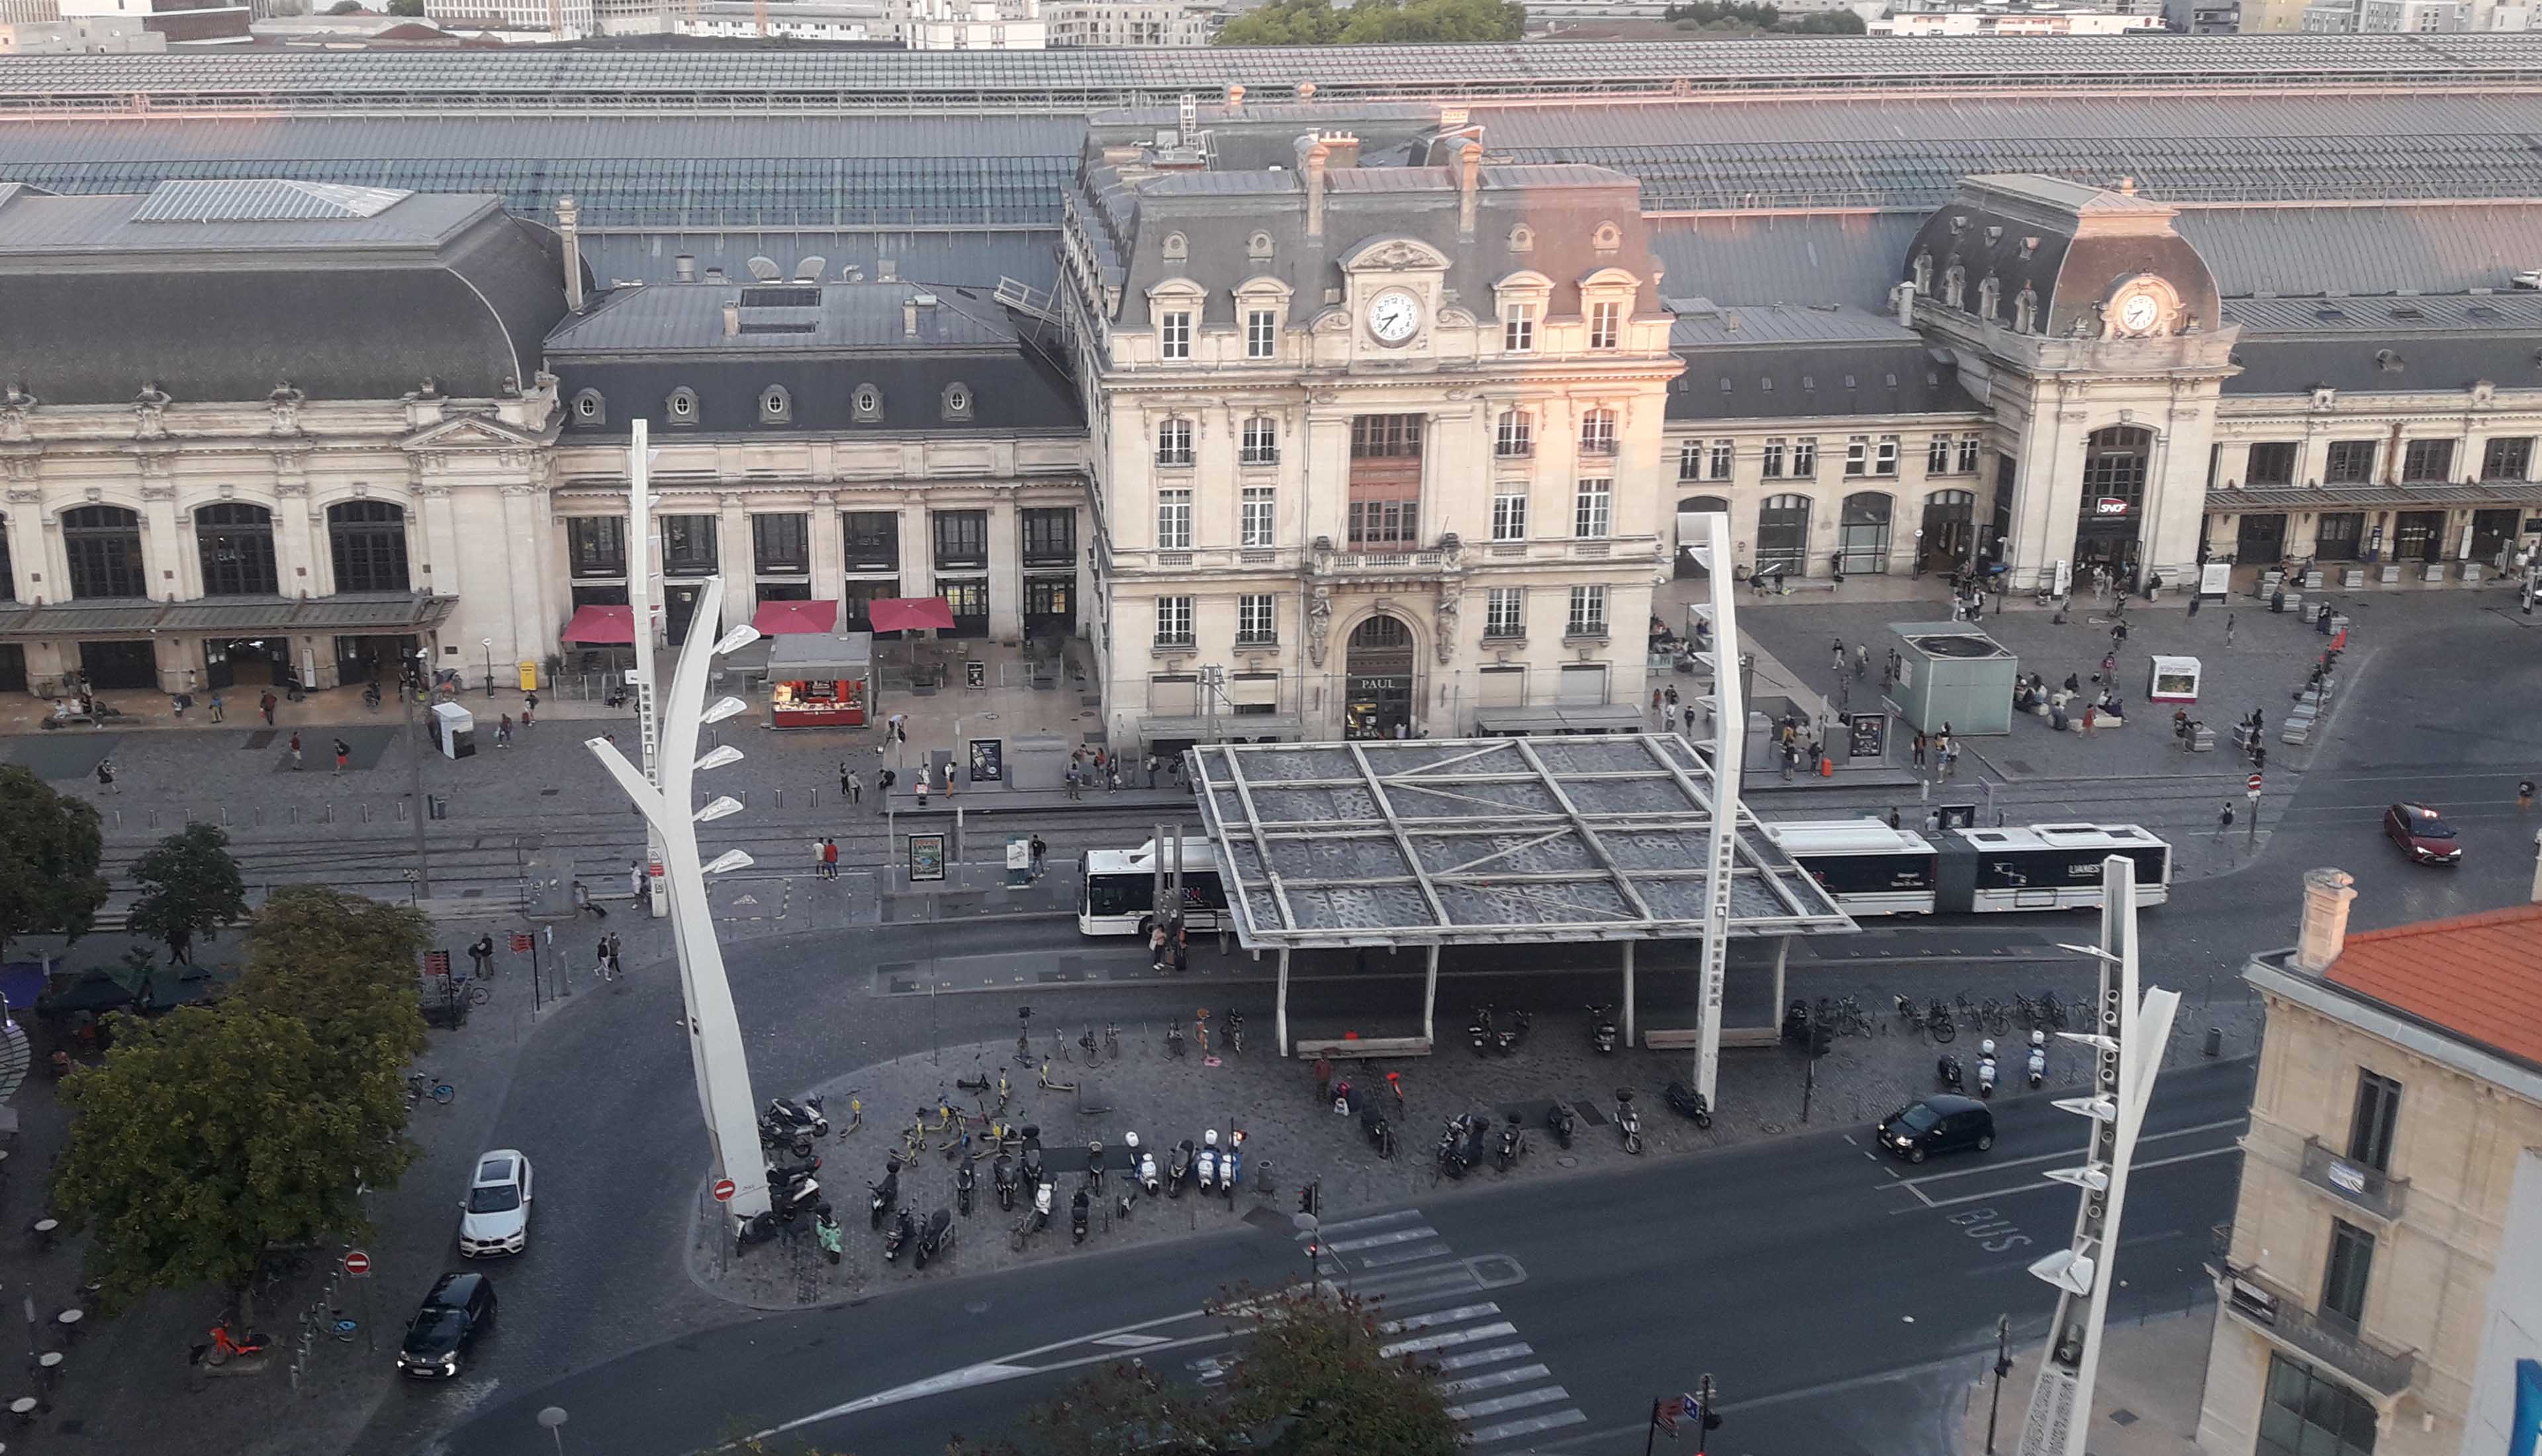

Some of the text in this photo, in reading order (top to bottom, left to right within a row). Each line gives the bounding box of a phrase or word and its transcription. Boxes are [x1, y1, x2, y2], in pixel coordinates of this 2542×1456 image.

[2100, 504, 2127, 512] SNCF
[1362, 679, 1395, 689] PAUL
[1946, 1208, 2033, 1252] BUS
